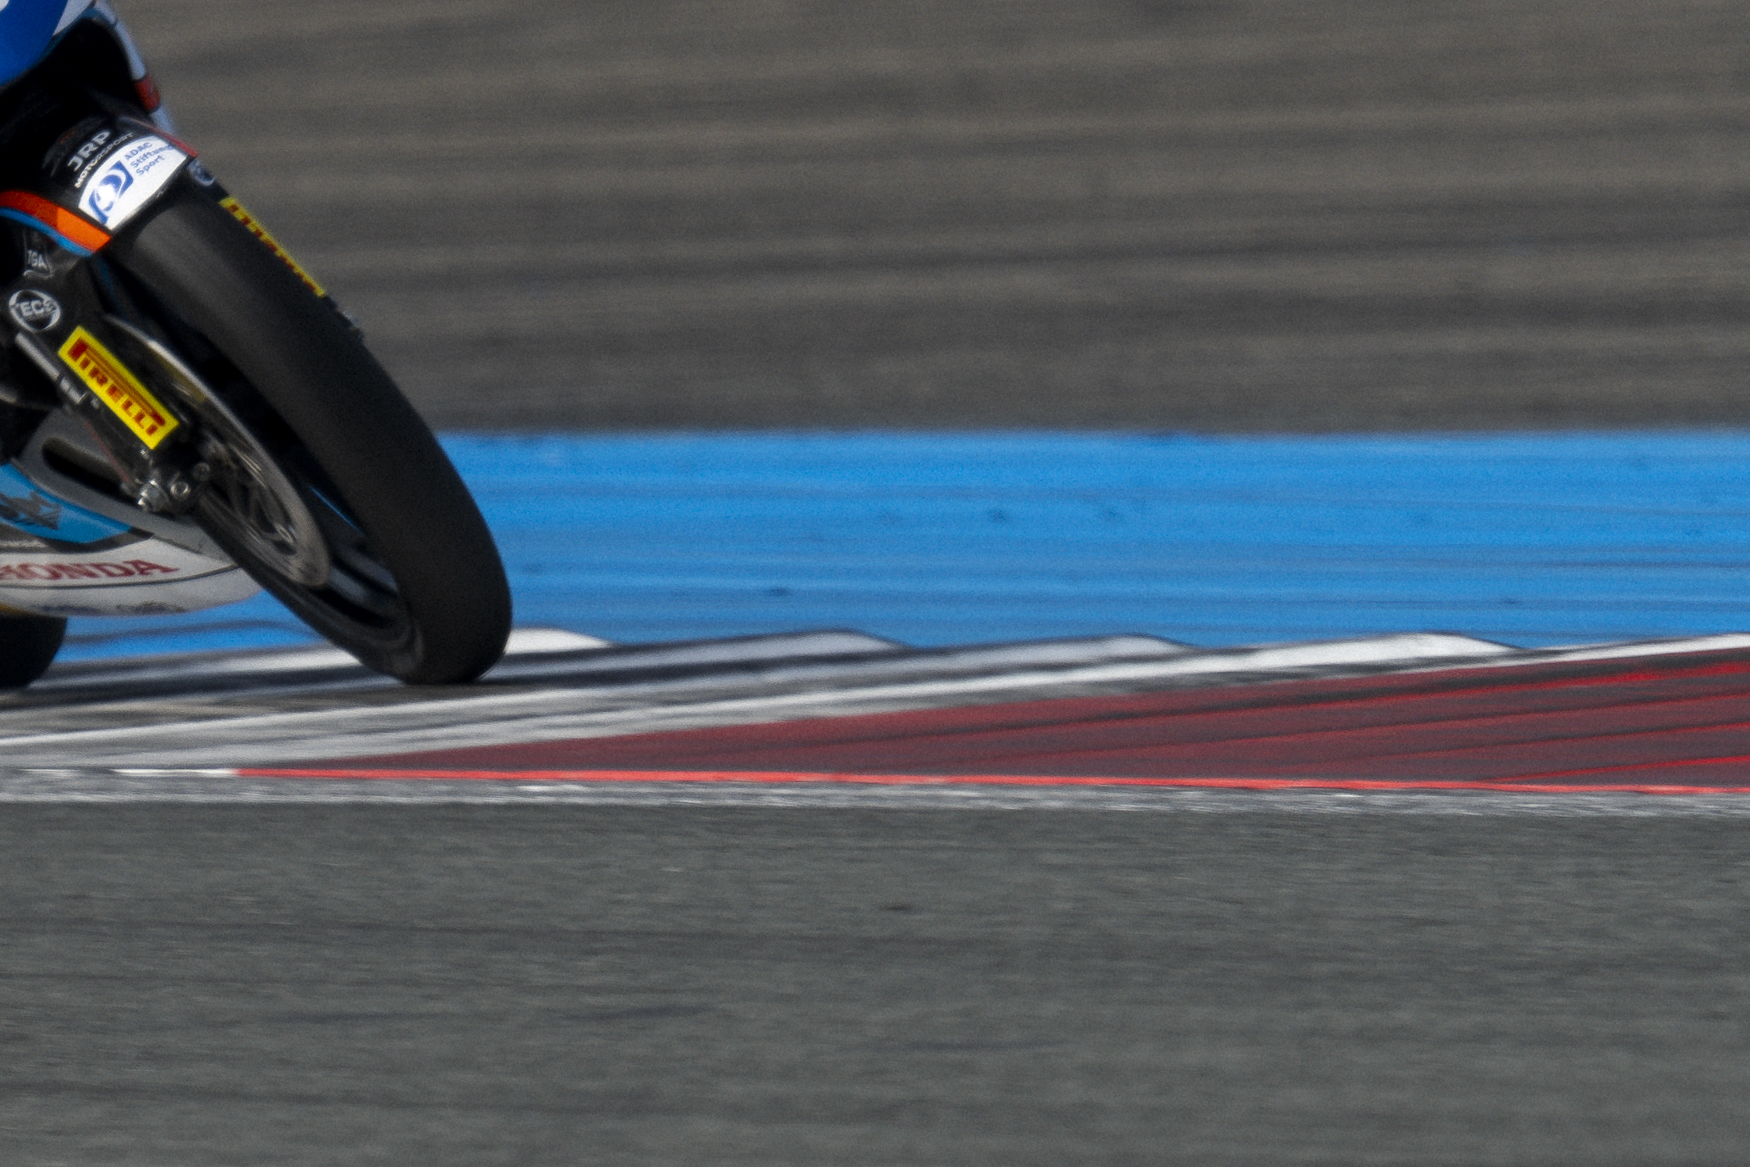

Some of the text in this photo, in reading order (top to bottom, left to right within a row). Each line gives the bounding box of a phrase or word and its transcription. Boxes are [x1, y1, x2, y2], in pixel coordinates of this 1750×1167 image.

[67, 131, 111, 172] JRP
[124, 141, 153, 162] ADAC
[136, 155, 165, 176] Sport
[68, 336, 167, 437] PIRELLI
